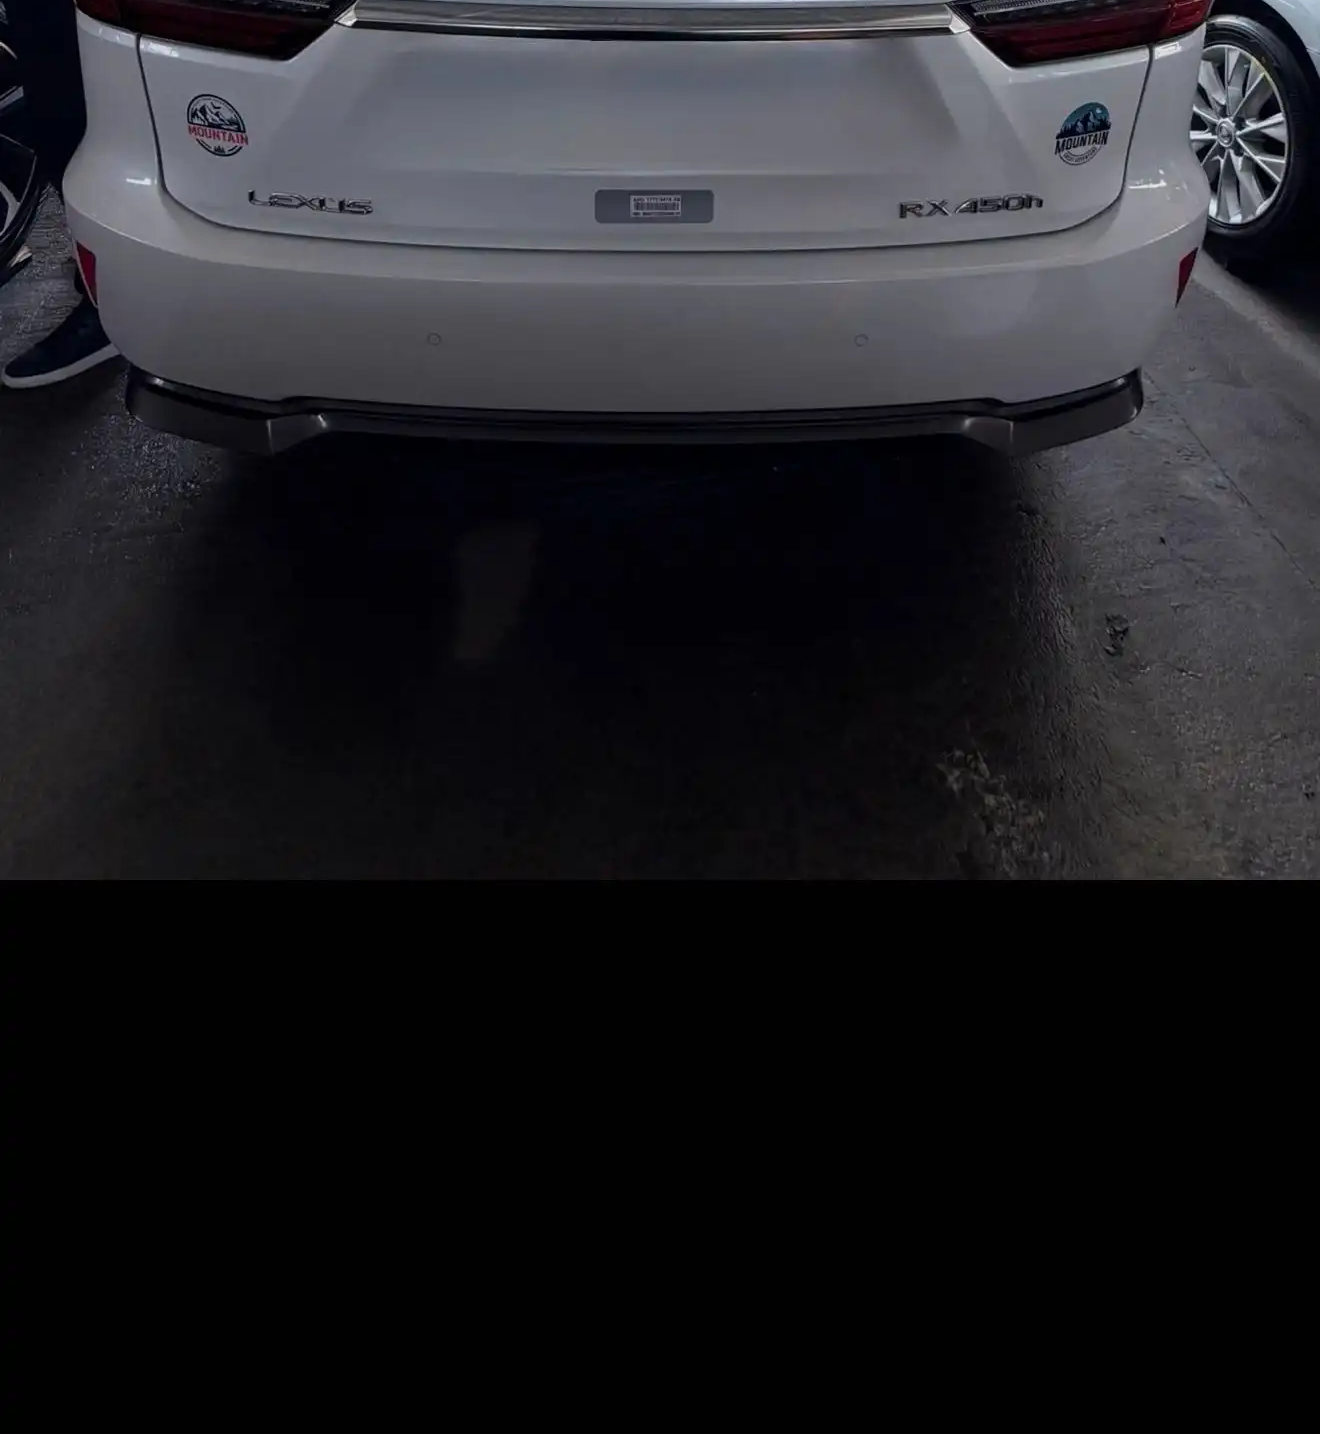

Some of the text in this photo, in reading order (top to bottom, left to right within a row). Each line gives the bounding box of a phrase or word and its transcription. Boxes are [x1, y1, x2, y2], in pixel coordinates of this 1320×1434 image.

[187, 124, 249, 146] MOUNTAIN
[1054, 130, 1110, 155] MOUNTAIN
[247, 189, 374, 215] LEXUS
[898, 192, 1044, 219] RX 450h
